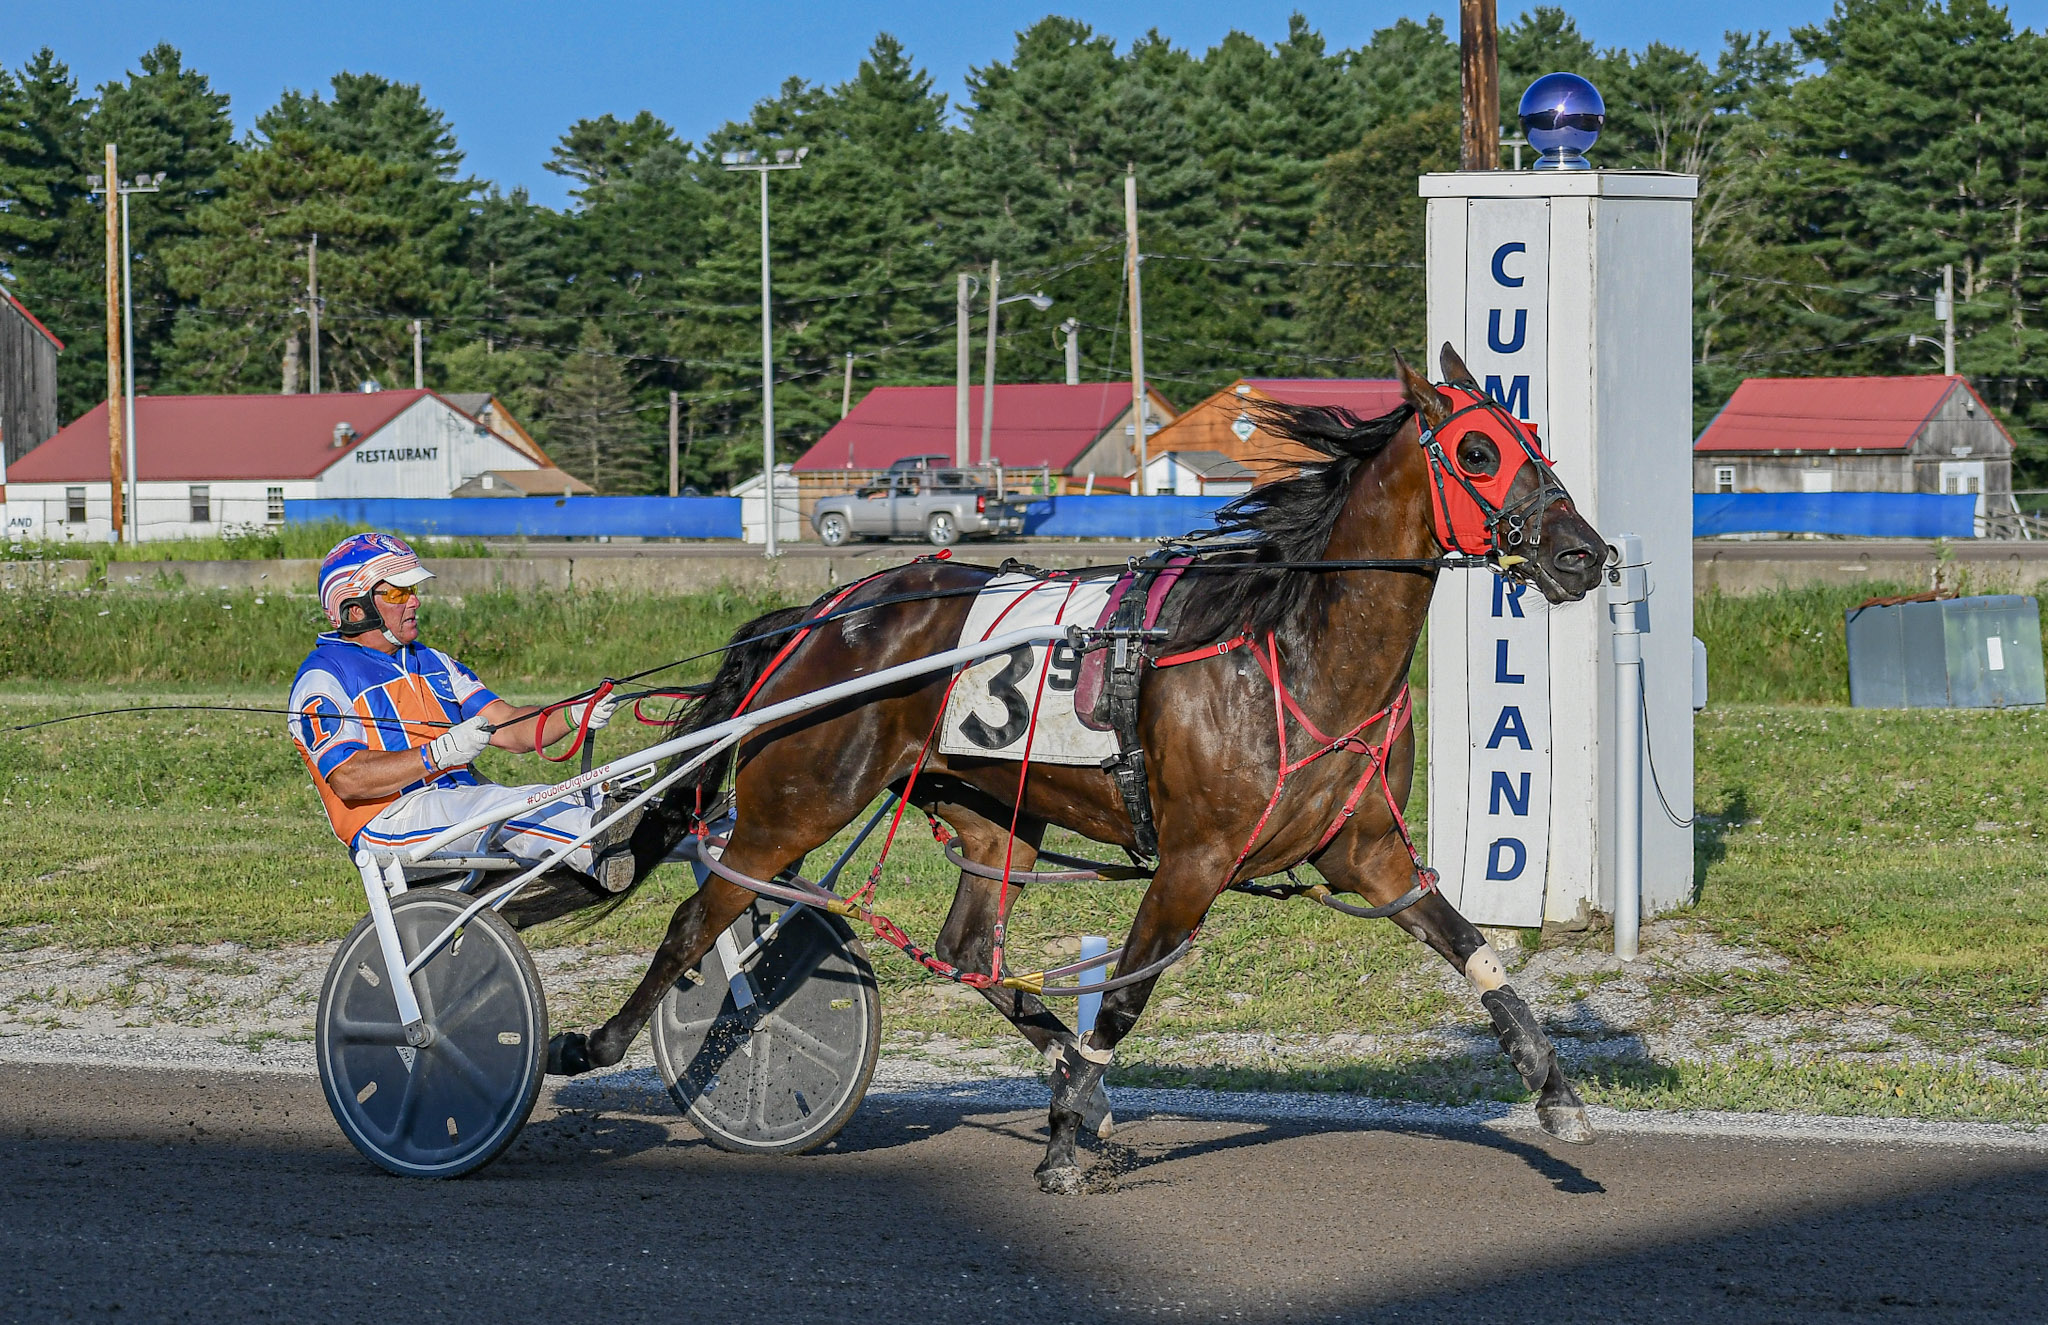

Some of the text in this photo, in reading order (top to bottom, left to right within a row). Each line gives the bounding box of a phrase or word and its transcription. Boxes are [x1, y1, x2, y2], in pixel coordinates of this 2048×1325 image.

[356, 447, 438, 463] RESTAURANT
[1485, 241, 1534, 881] CUMRLAND
[959, 639, 1035, 750] 3
[526, 764, 610, 805] #DoubleDigitDave
